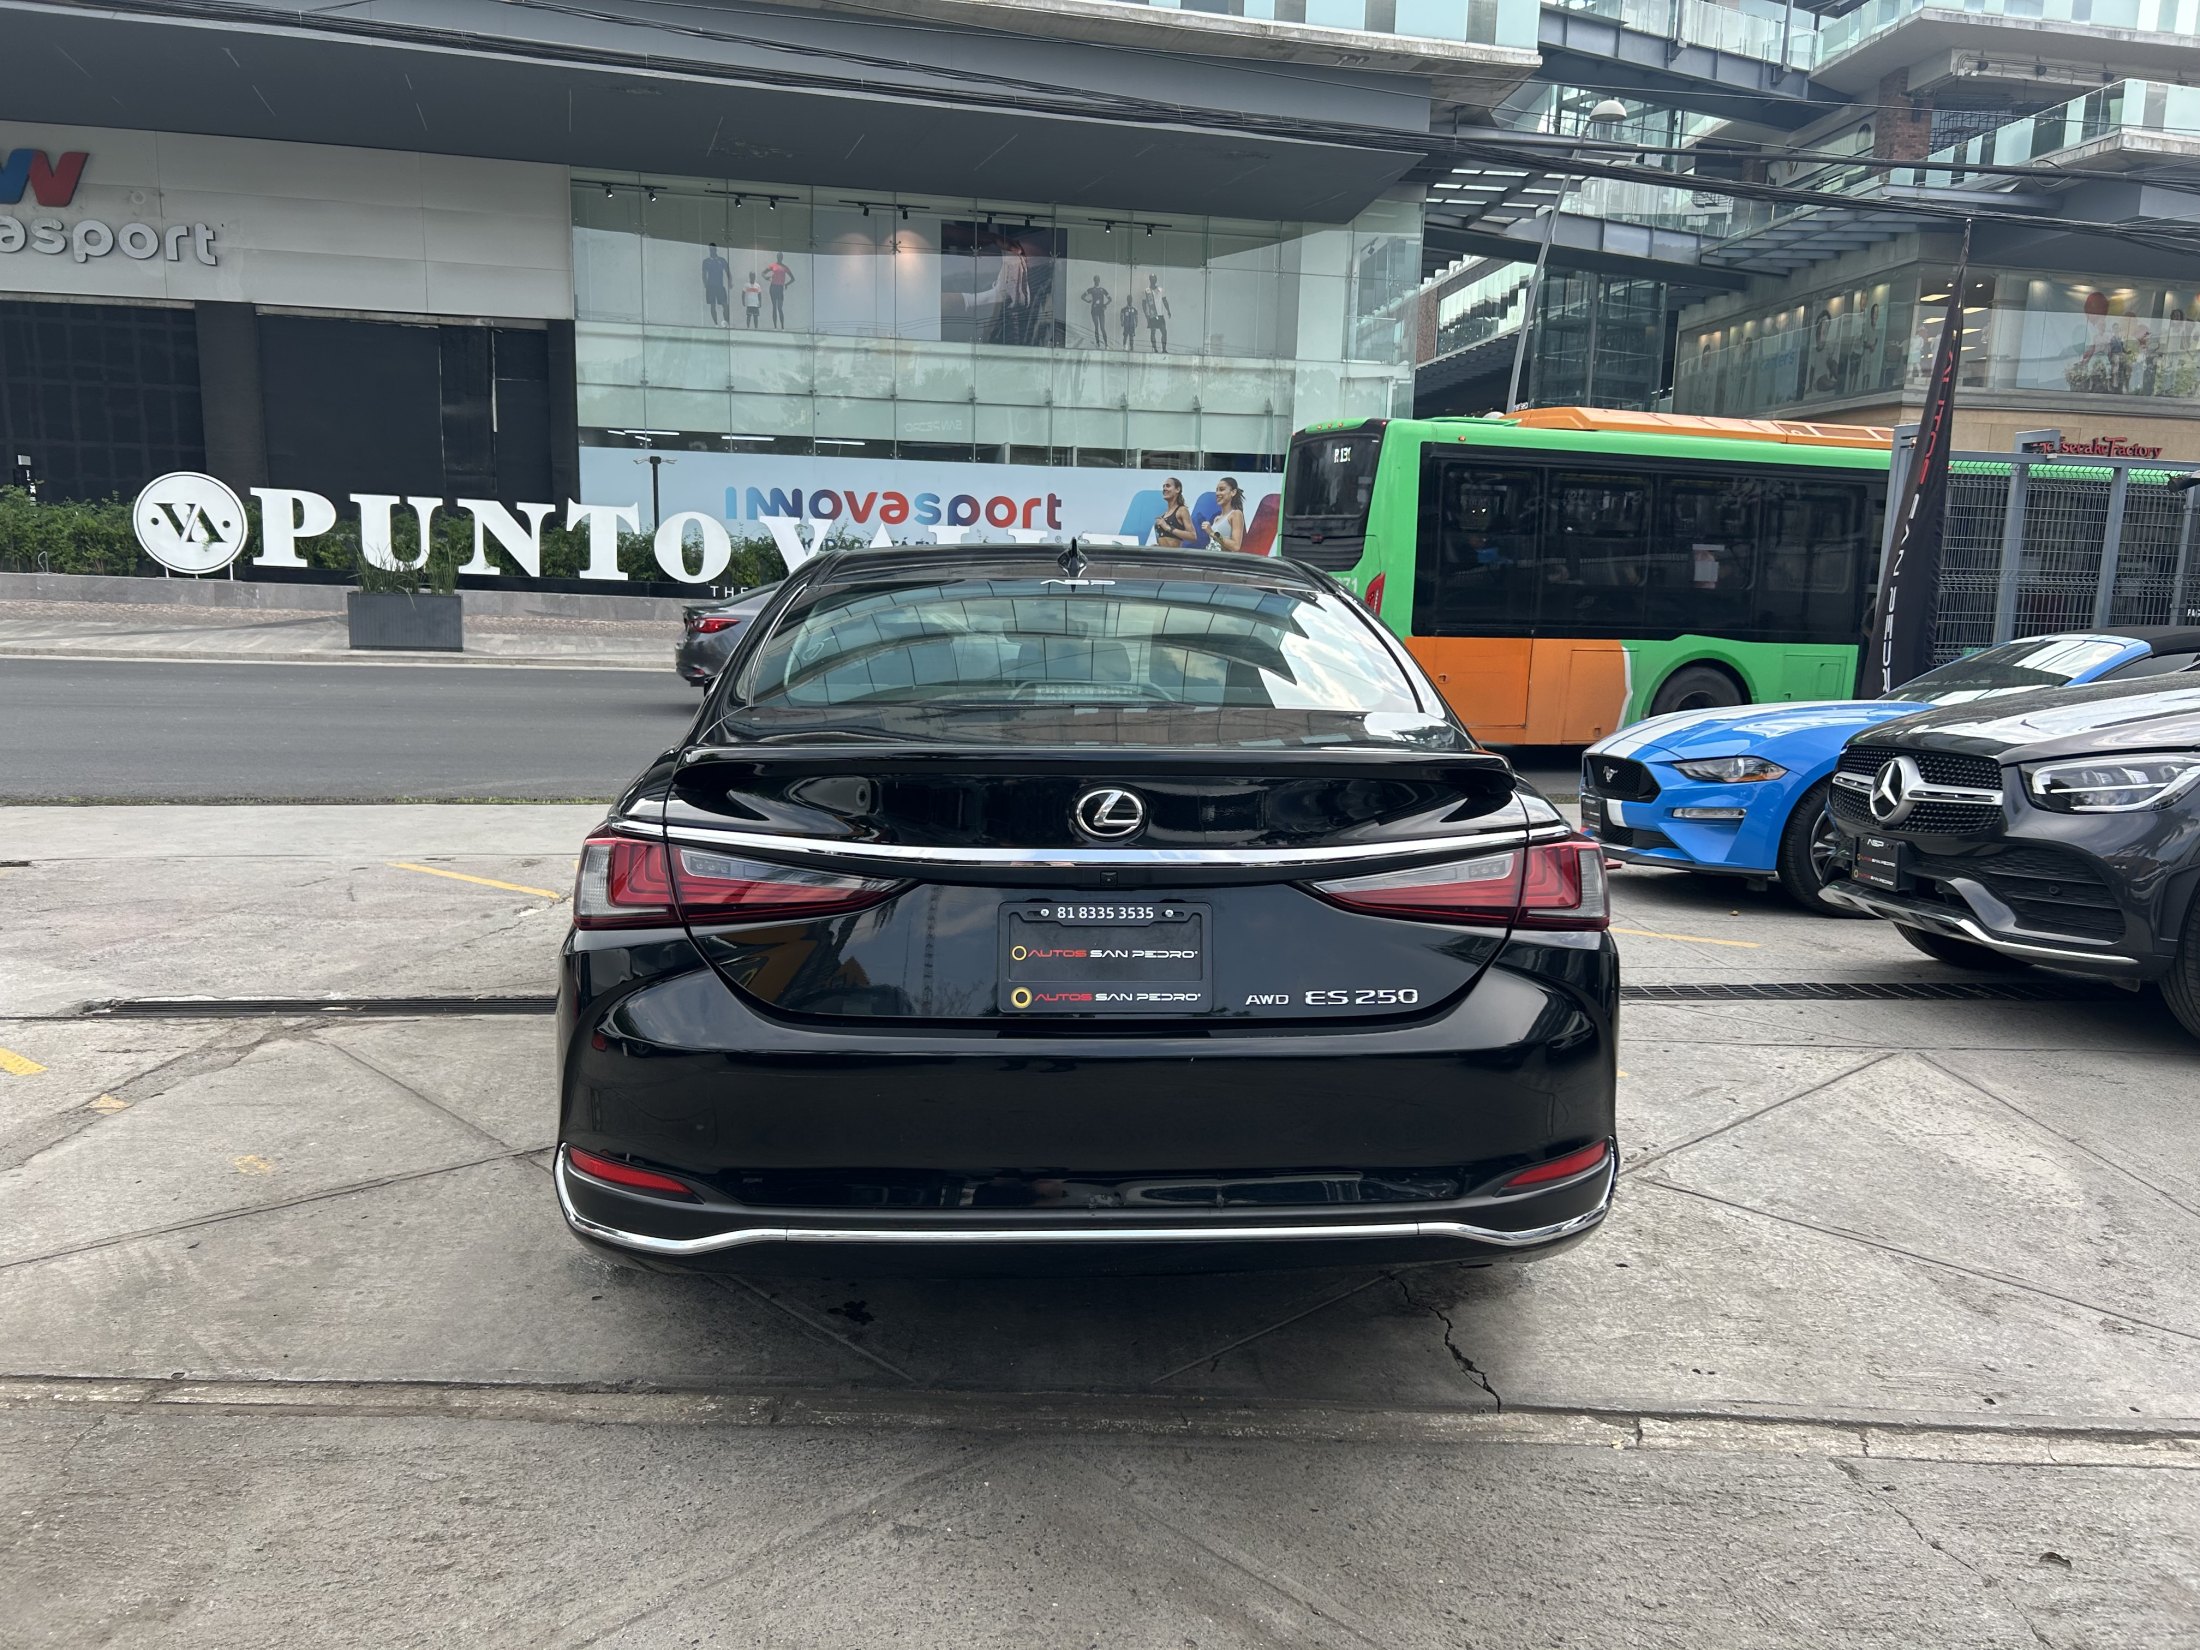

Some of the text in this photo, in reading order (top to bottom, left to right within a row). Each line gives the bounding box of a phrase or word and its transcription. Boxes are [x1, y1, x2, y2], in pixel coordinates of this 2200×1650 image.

[250, 486, 732, 584] PUNTO
[1057, 907, 1154, 919] 81 8335 3535
[1028, 950, 1088, 958] AUTOS
[1090, 950, 1129, 958] SAN
[1034, 993, 1093, 1001] AUTOS
[1095, 993, 1133, 1001] SAN
[1245, 988, 1418, 1005] AWD ES 250
